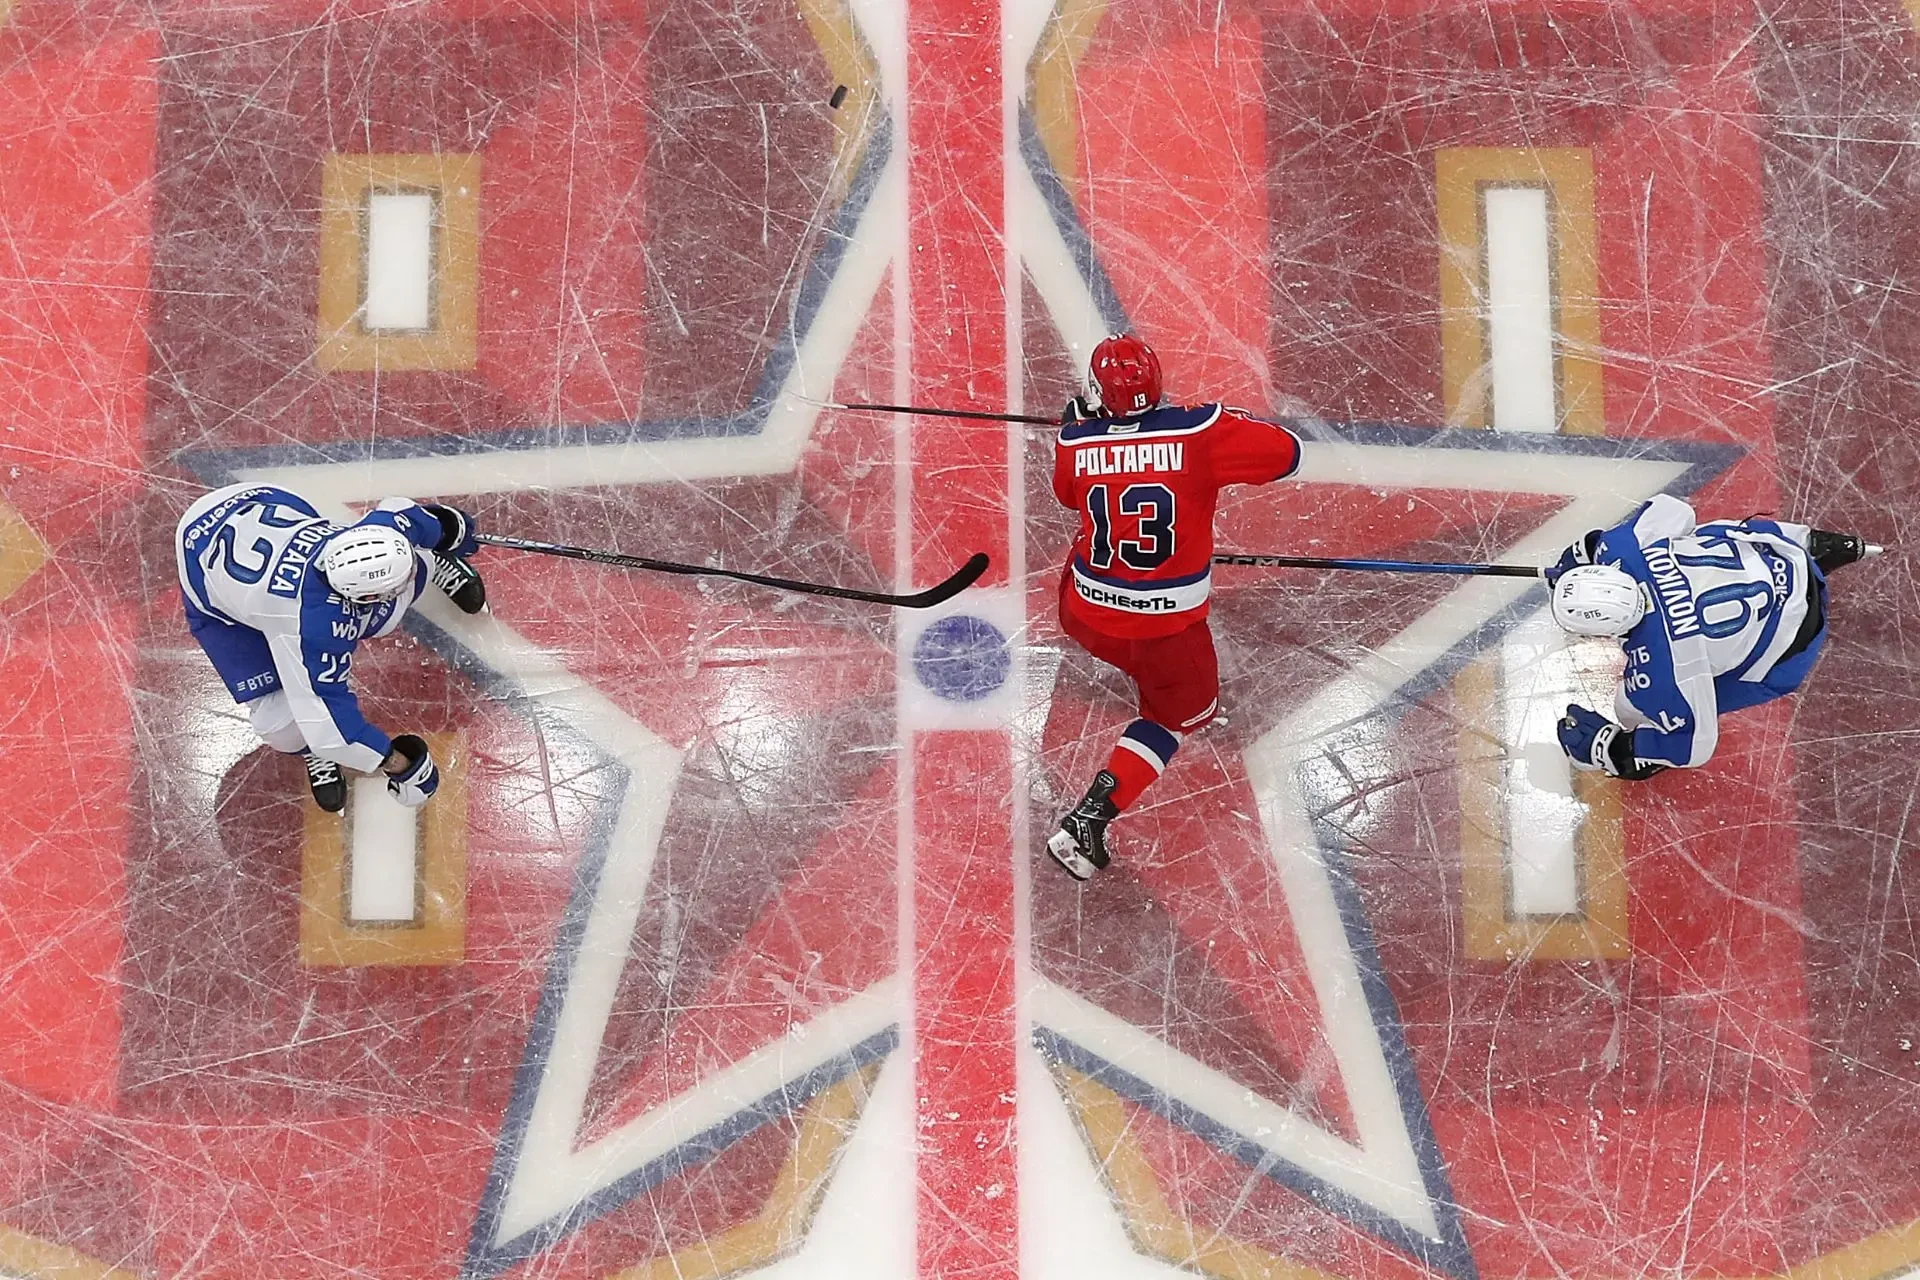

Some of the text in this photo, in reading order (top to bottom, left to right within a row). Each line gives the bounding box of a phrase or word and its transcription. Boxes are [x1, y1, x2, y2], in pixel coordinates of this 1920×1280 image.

[1134, 393, 1147, 408] 13
[1075, 442, 1183, 477] POLTAPOV
[1087, 483, 1176, 570] 13
[1642, 545, 1699, 636] NOVIKOV
[1584, 609, 1602, 620] ВТБ
[247, 671, 275, 692] ВТБ
